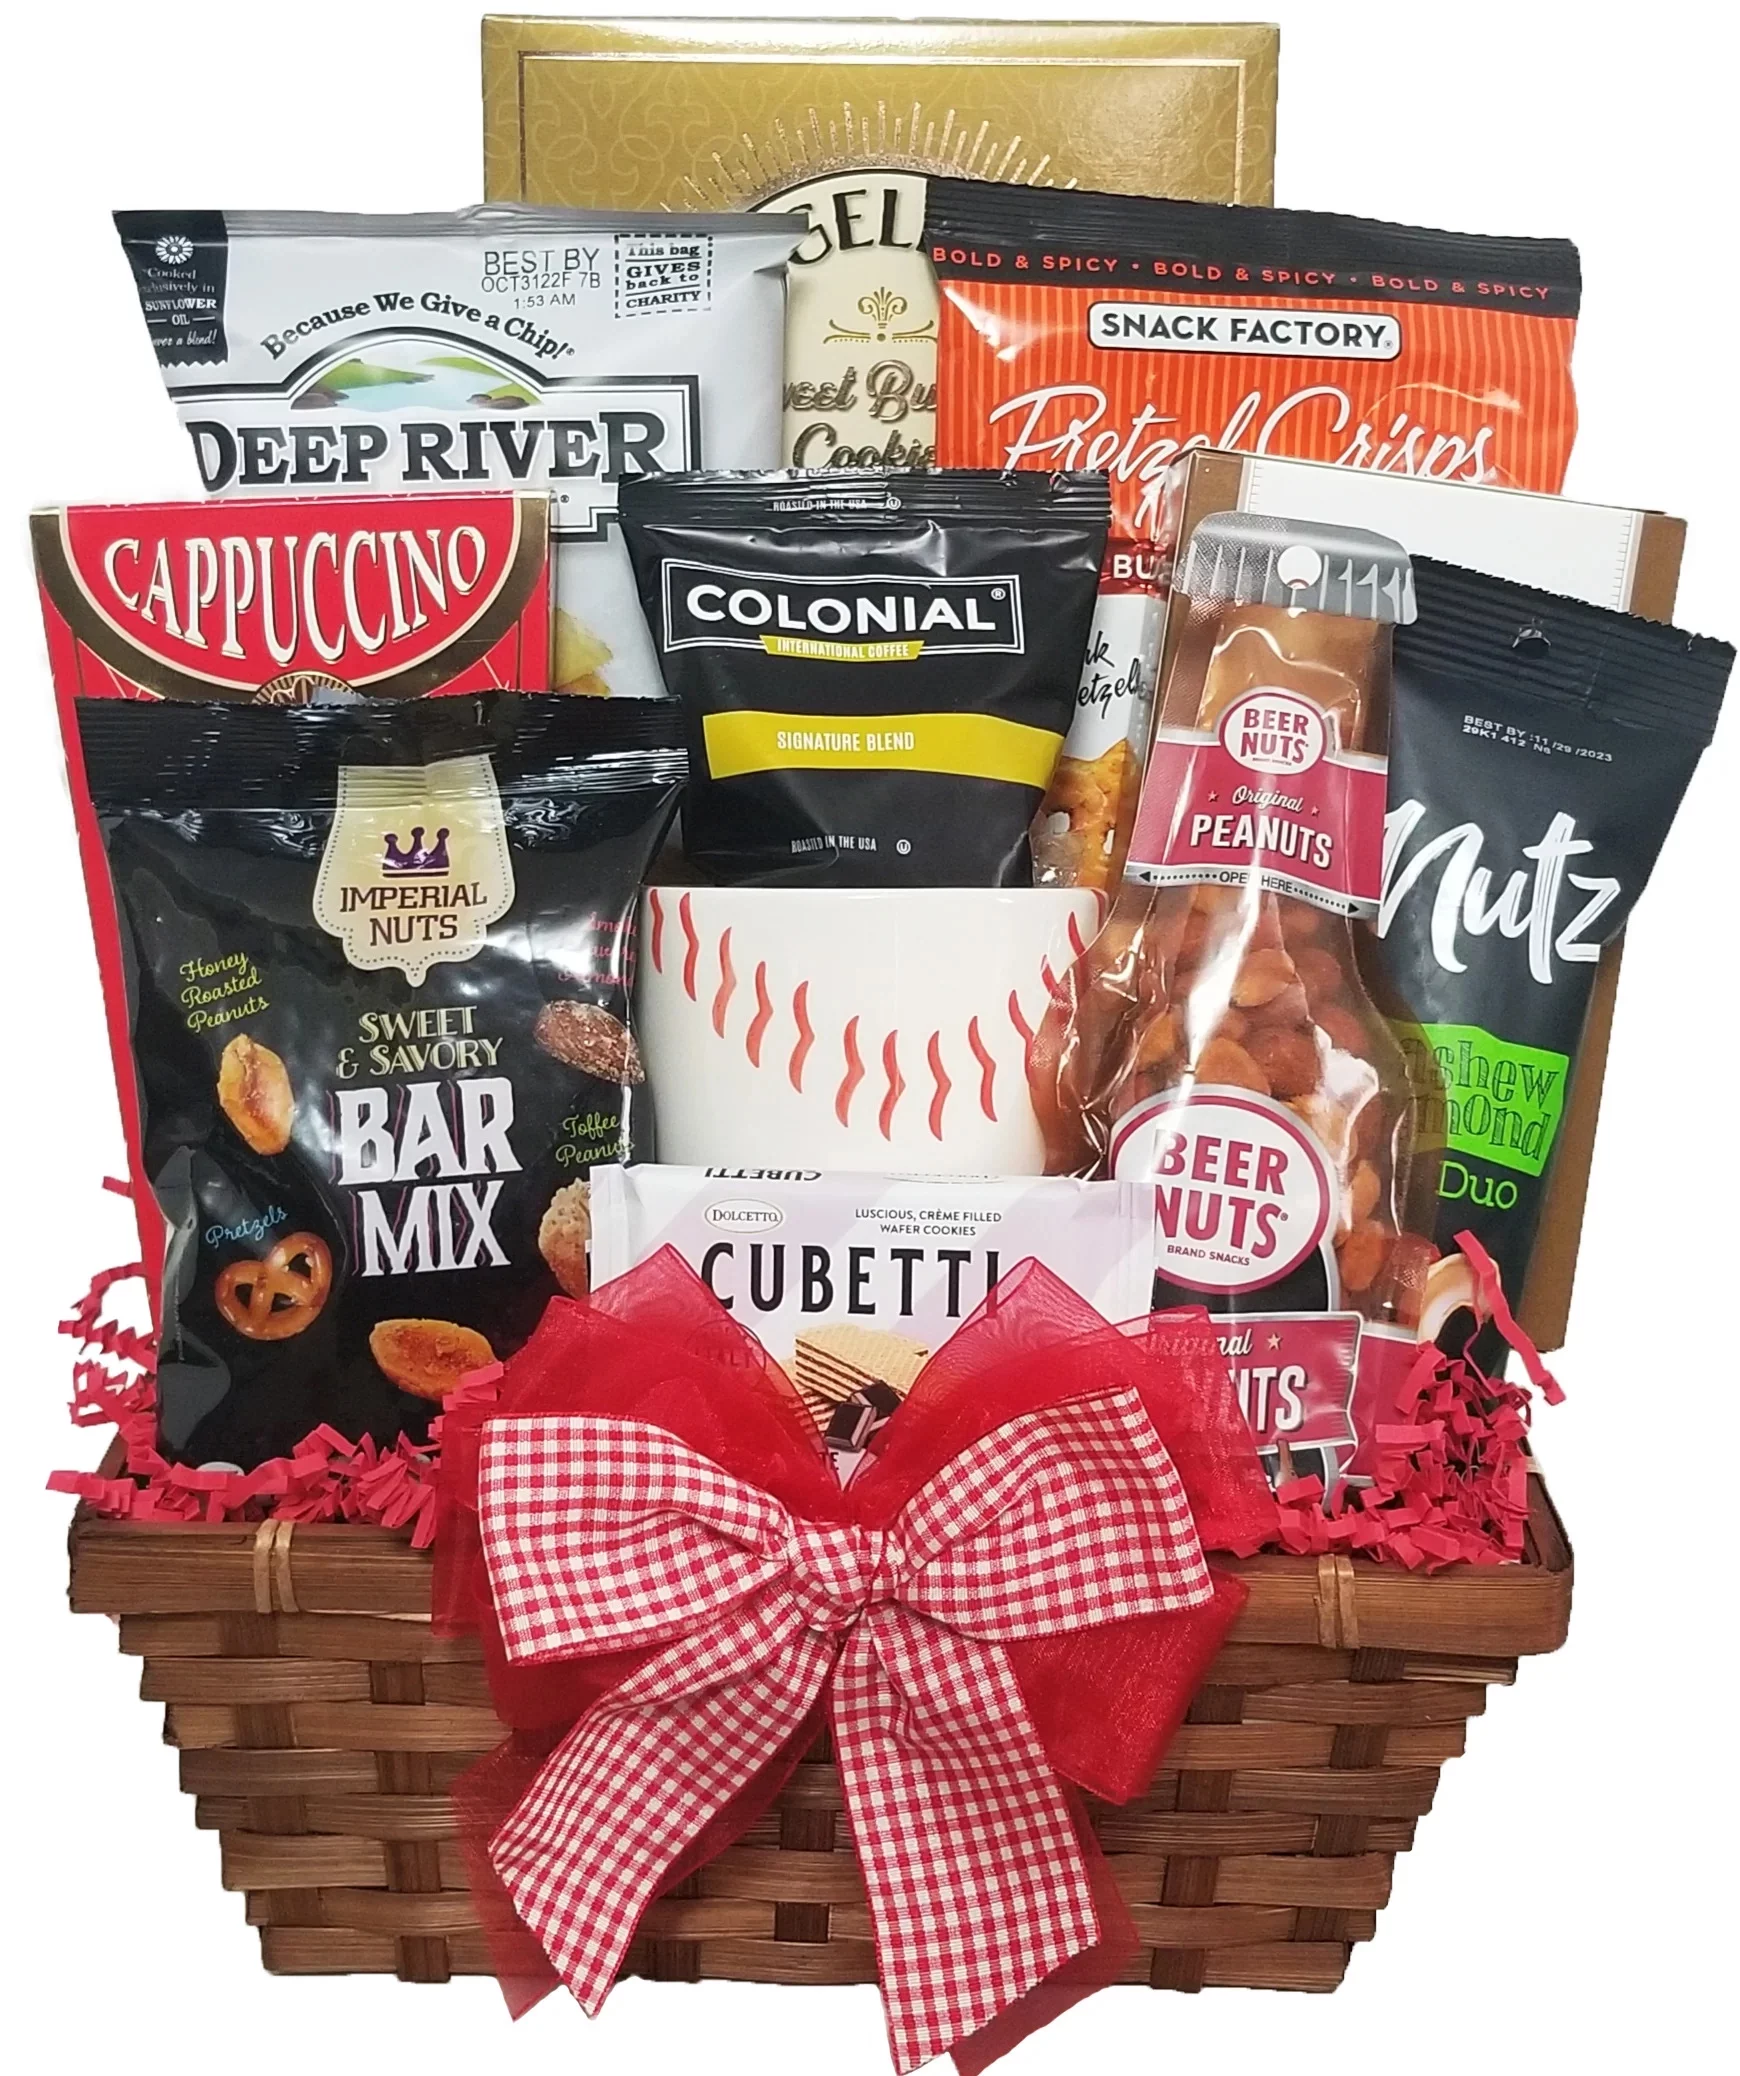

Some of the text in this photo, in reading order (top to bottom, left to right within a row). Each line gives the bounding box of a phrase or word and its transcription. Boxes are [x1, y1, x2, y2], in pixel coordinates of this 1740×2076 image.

[484, 247, 600, 276] BEST BY
[626, 243, 701, 259] This bag
[481, 271, 601, 293] OCT3122F 7B
[625, 261, 702, 279] GIVES
[625, 272, 700, 291] back to
[933, 247, 1550, 301] BOLD & SPICY BOLD & SPICY BOLD & SPICY
[203, 283, 215, 293] in
[513, 293, 576, 310] 1:53 AM
[625, 290, 702, 309] CHARITY
[144, 298, 217, 311] SUNFLOWER
[171, 313, 190, 325] OIL
[260, 291, 569, 361] Because We Give a Chip!
[1101, 312, 1387, 349] SNACK FACTORY
[185, 411, 666, 493] DEEP RIVER
[989, 384, 1495, 528] Pretzel Crisps
[773, 499, 867, 512] ROASTED IN THE USA
[103, 524, 488, 668] CAPPUCCINO
[686, 583, 997, 634] COLONIAL
[776, 638, 910, 659] INTERNATIONAL COFFEE
[1243, 708, 1310, 737] BEER
[1463, 714, 1504, 732] BEST
[1506, 726, 1527, 739] BY
[776, 730, 915, 752] SIGNATURE BLEND
[1240, 732, 1306, 765] NUTS
[1500, 734, 1527, 748] 412
[1231, 784, 1305, 814] Original
[791, 834, 878, 854] ROASTED IN THE USA
[1189, 813, 1333, 869] PEANUTS
[1218, 870, 1294, 894] OPE HERE
[339, 882, 489, 913] IMPERIAL
[369, 913, 458, 947] NUTS
[179, 952, 250, 983] Honey
[180, 966, 263, 1010] Roasted
[186, 995, 271, 1034] Peanuts
[358, 1005, 478, 1043] SWEET
[335, 1036, 504, 1080] & SAVORY
[334, 1076, 524, 1186] BAR
[561, 1111, 621, 1141] Toffee
[1154, 1129, 1290, 1196] BEER
[1438, 1160, 1519, 1210] Duo
[204, 1203, 290, 1249] Pretzels
[355, 1179, 512, 1278] MIX
[854, 1208, 1003, 1223] LUSCIOUS, CRÈME FILLED
[880, 1224, 977, 1237] WAFER COOKIES
[1155, 1184, 1283, 1260] NUTS
[1166, 1243, 1251, 1266] BRAND SNACKS
[701, 1241, 1000, 1320] CUBETTI
